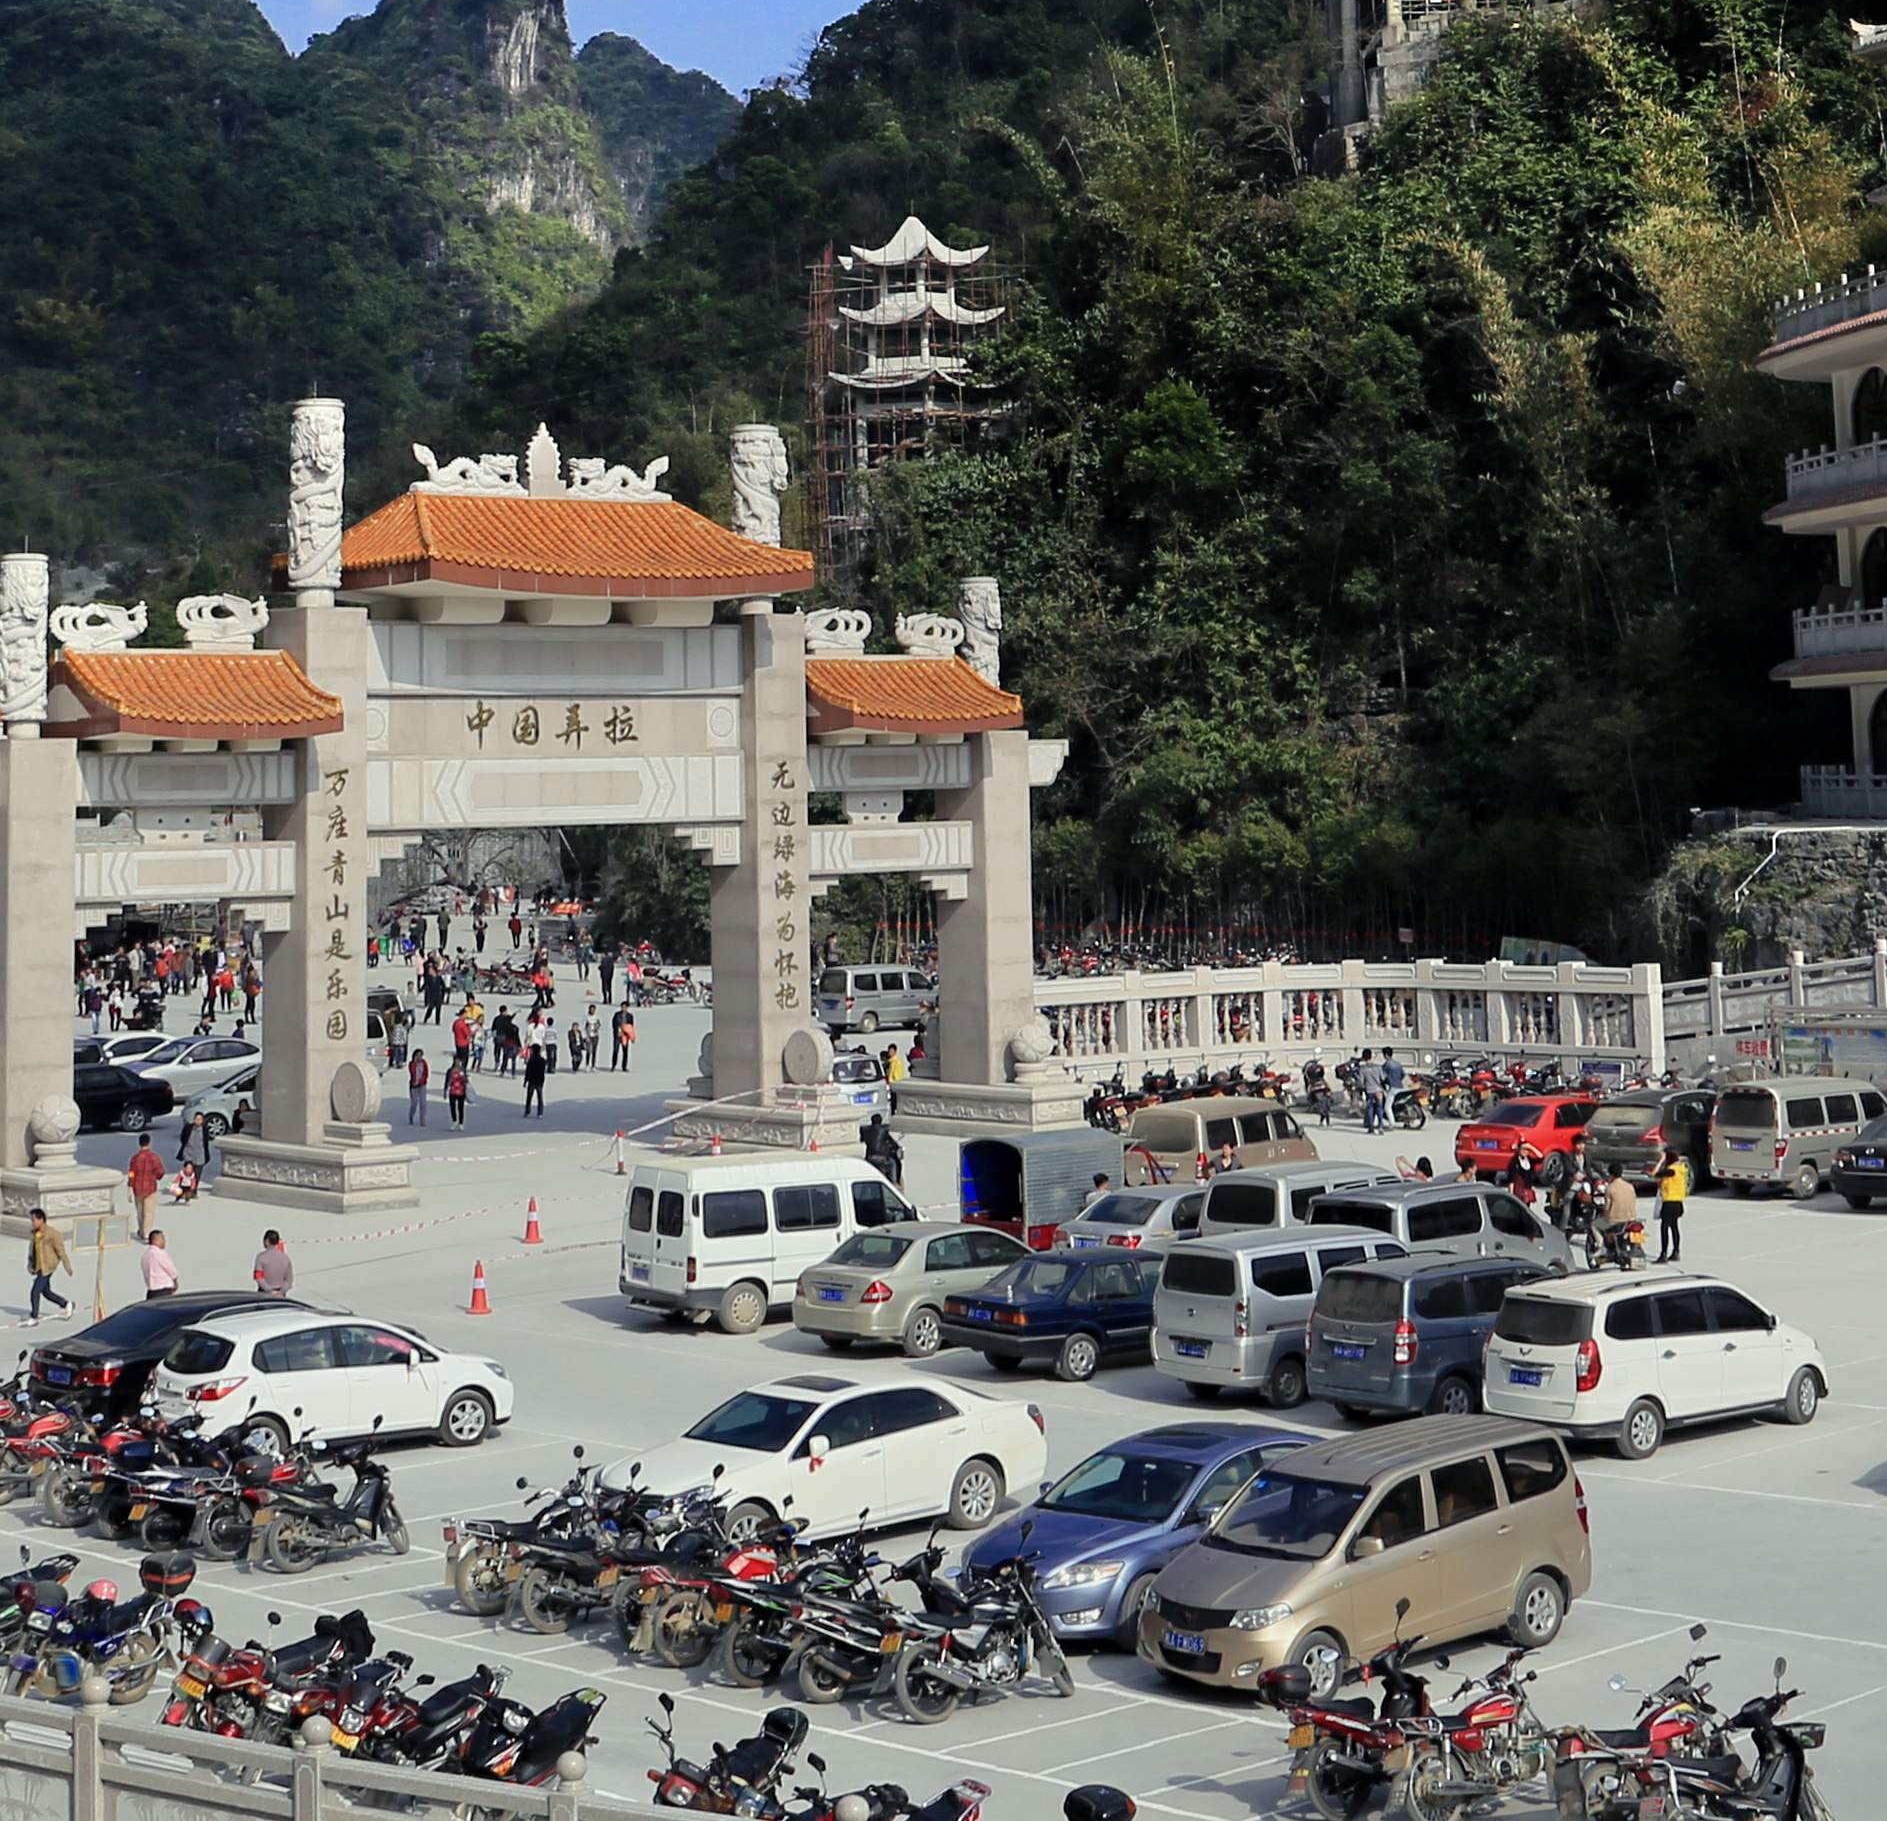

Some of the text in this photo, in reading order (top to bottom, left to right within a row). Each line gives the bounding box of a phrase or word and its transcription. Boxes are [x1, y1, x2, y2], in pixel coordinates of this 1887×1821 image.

[323, 767, 353, 1041] 万座青山是乐园
[770, 760, 800, 1011] 无边绿海为怀抱
